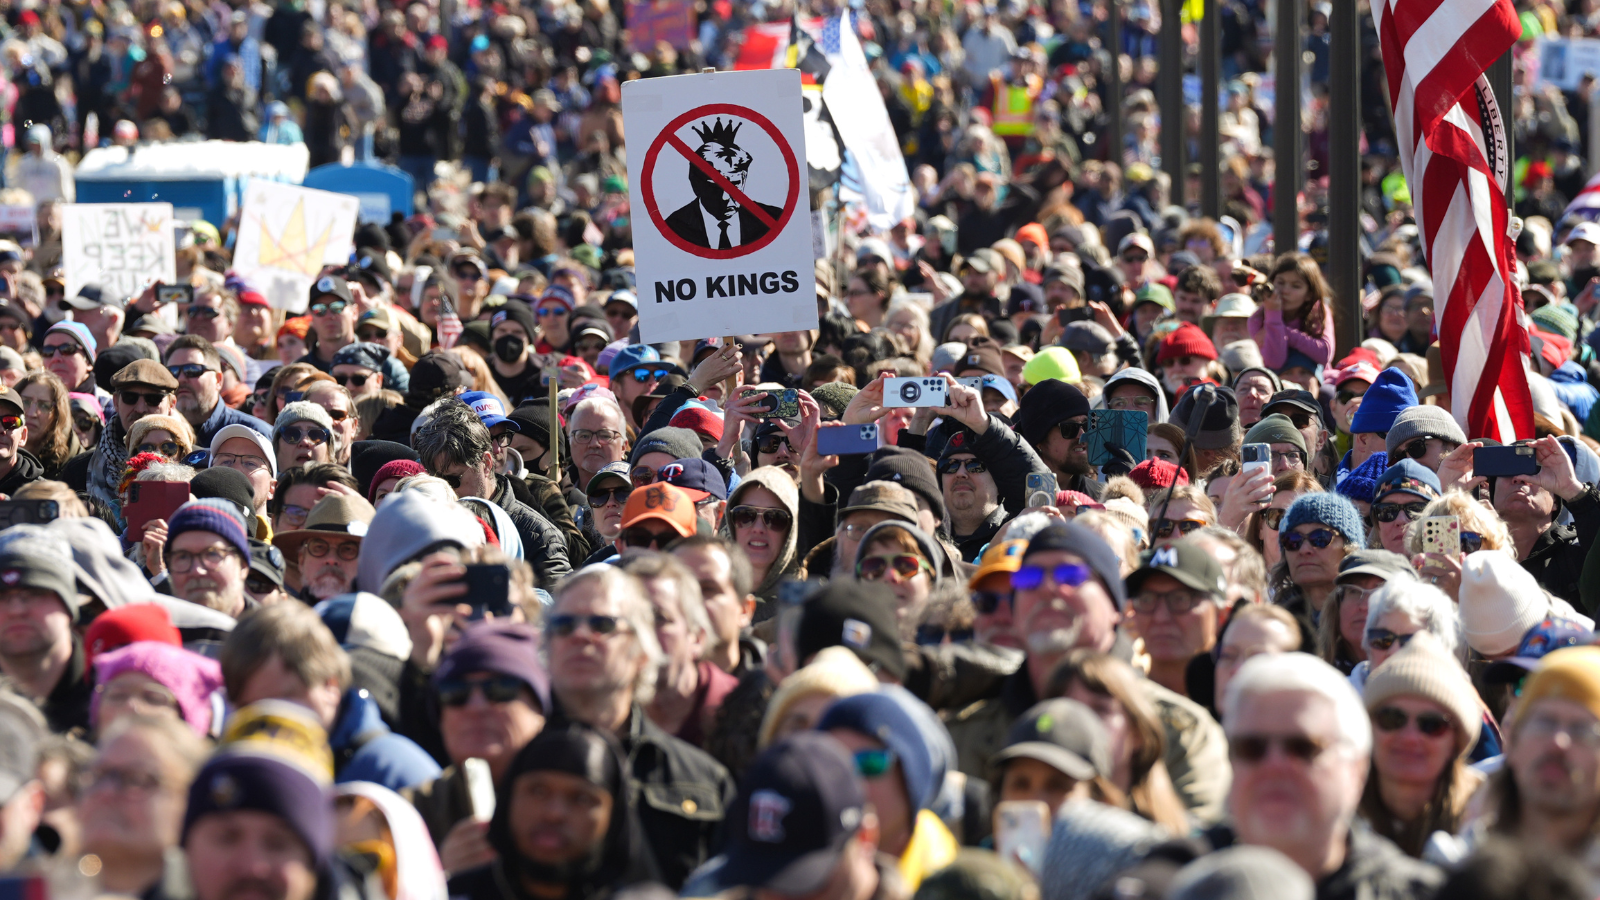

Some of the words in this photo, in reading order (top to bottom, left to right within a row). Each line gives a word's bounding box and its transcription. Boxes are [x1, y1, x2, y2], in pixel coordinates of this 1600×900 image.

[1482, 86, 1504, 179] LIBERTY
[654, 278, 697, 304] NO
[706, 270, 799, 299] KINGS
[475, 403, 500, 413] NASA
[663, 463, 683, 481] T
[1149, 546, 1178, 569] M
